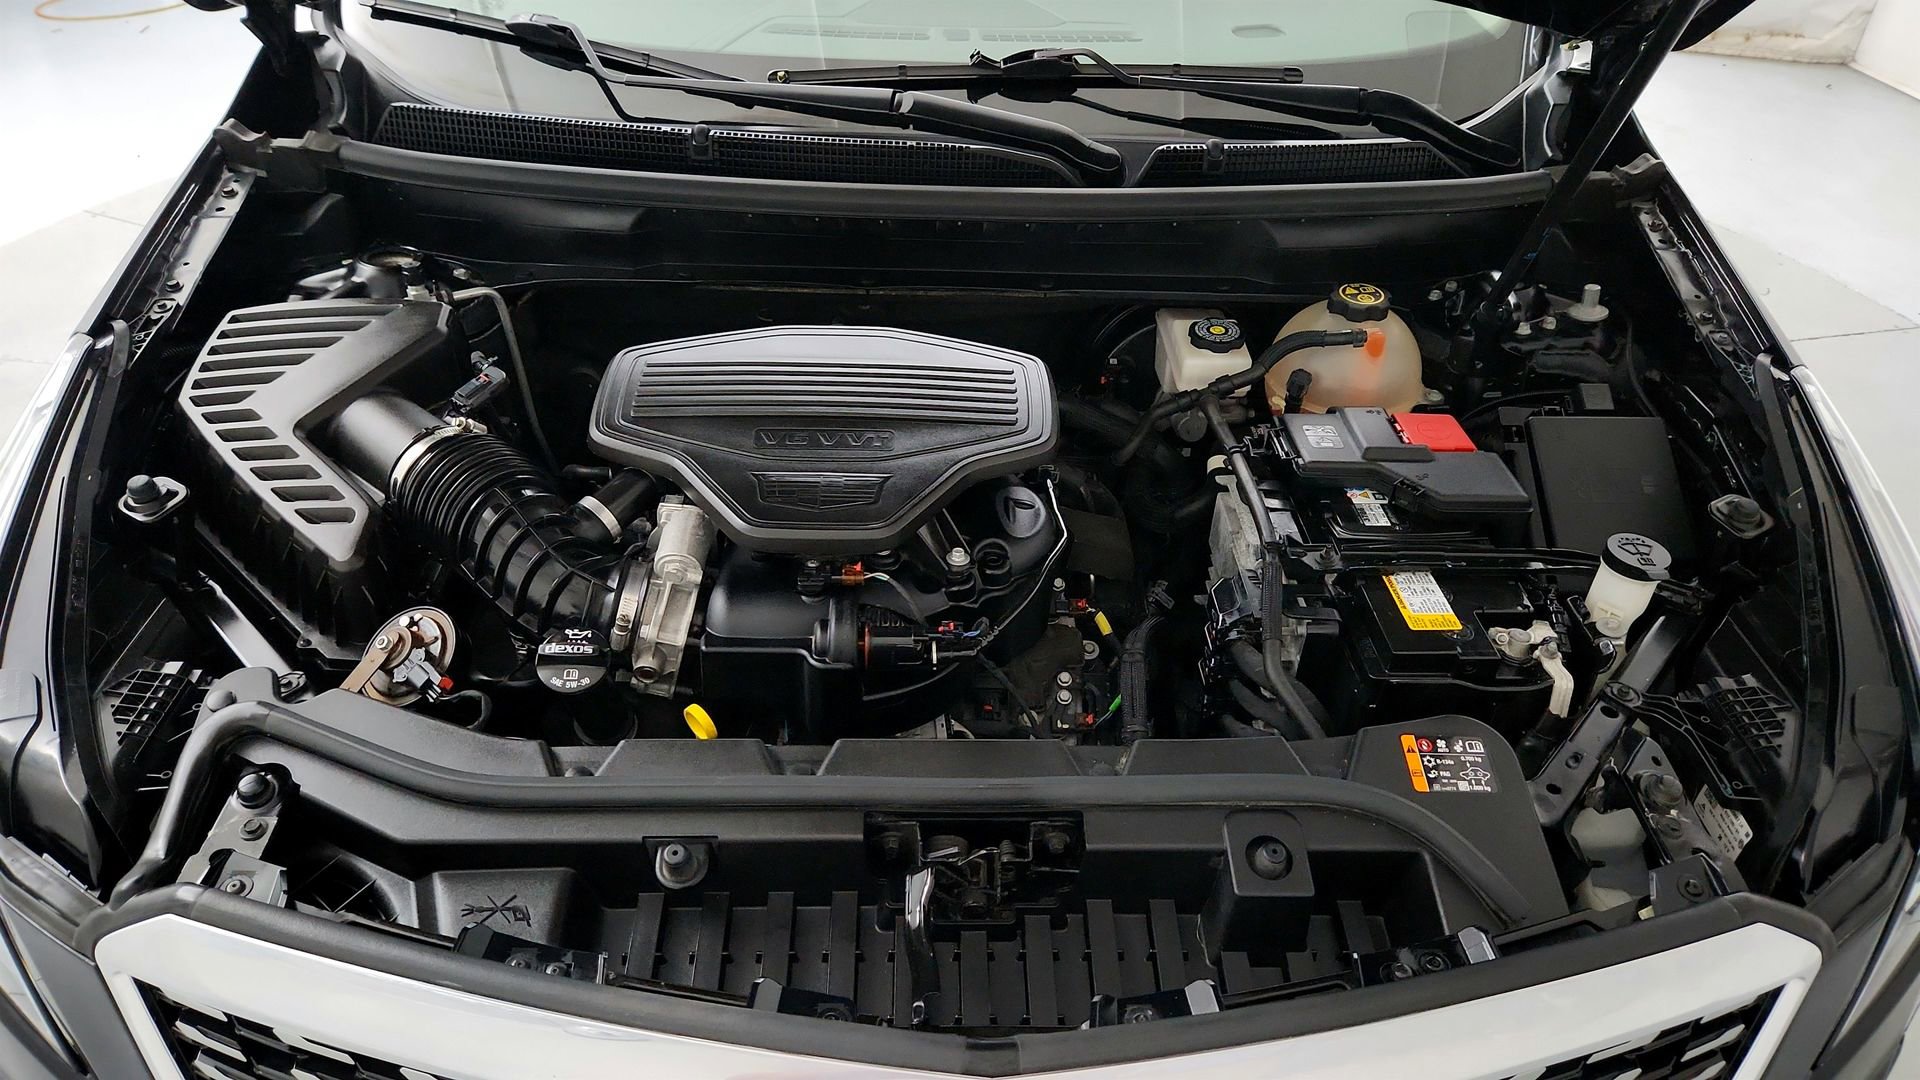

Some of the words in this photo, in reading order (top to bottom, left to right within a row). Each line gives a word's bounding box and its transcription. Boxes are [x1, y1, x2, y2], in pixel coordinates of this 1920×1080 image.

[759, 431, 809, 445] V6
[816, 431, 892, 446] VVT
[544, 642, 594, 654] dexos
[550, 676, 564, 687] SAE
[565, 677, 590, 689] 5W-30
